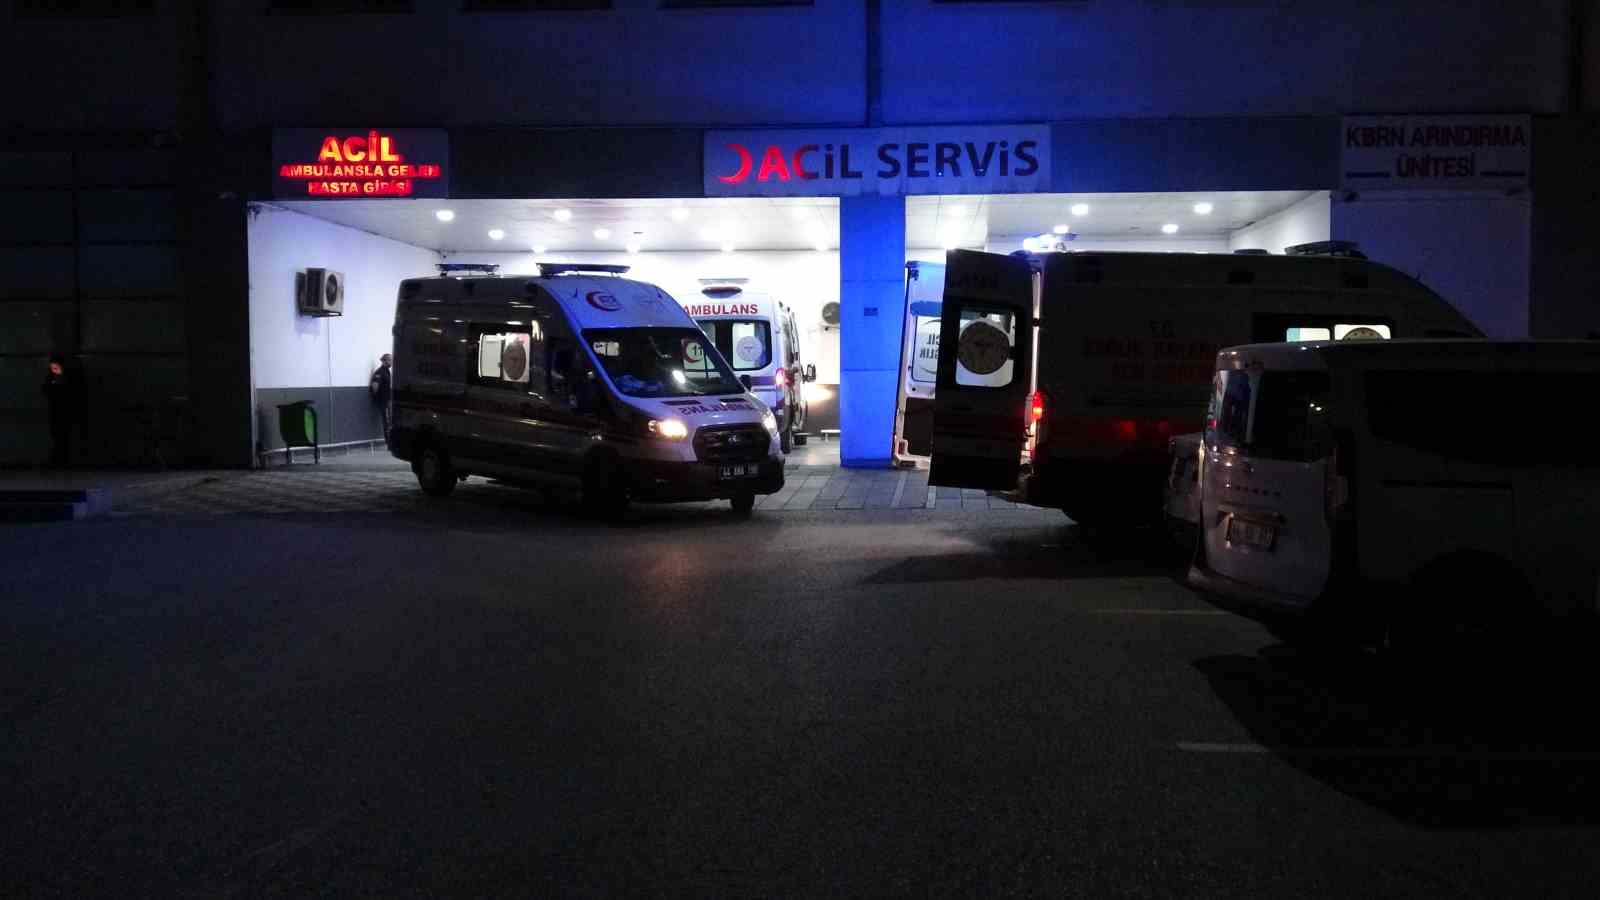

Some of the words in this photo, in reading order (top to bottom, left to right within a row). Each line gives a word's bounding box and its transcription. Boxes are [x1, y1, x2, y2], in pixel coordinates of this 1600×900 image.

[1346, 127, 1404, 146] KBRN
[1410, 127, 1526, 146] ARINDIRMA
[319, 130, 401, 162] ACİL
[279, 165, 384, 177] AMBULANSLA
[388, 165, 440, 177] GELEN
[1398, 152, 1475, 177] ÜNİTESİ
[308, 181, 359, 193] HASTA
[684, 304, 758, 315] AMBULANS
